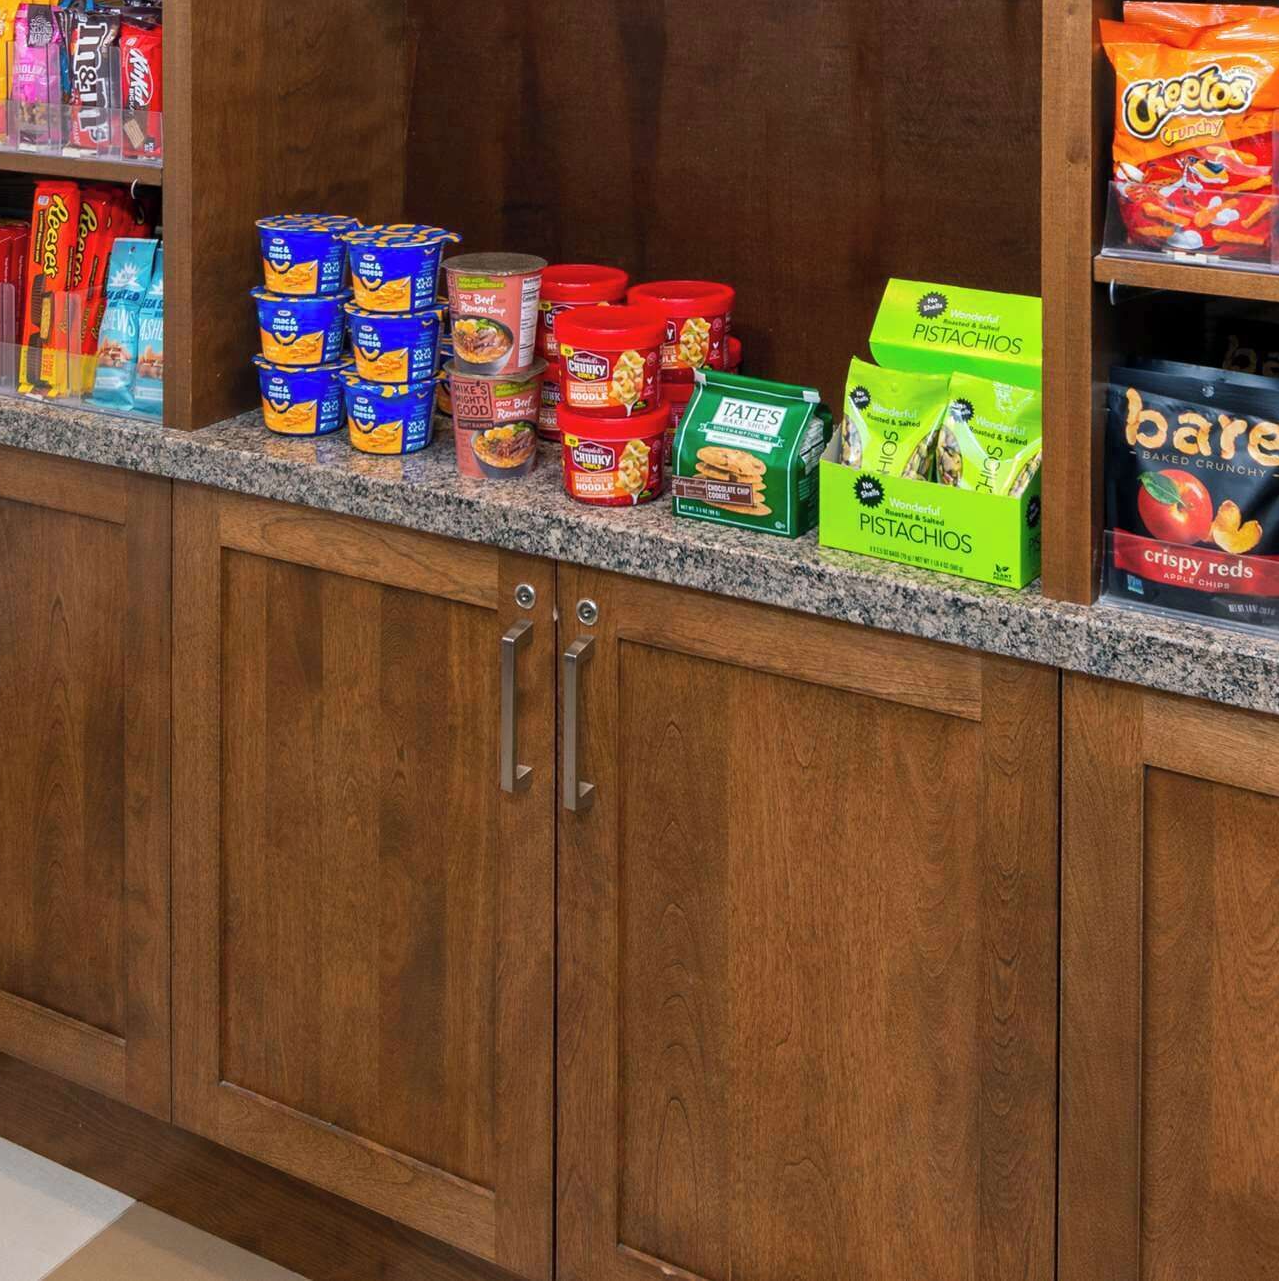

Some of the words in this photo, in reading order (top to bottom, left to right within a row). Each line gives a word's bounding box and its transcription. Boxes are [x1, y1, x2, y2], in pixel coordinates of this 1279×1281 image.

[1124, 64, 1256, 138] Cheetos
[1160, 118, 1224, 147] Crunchy
[42, 194, 69, 279] Reese's
[923, 302, 943, 312] Shells
[927, 297, 938, 305] No
[950, 309, 1000, 323] Wonderful
[943, 318, 970, 328] Roasted
[979, 323, 1000, 332] Salted
[913, 323, 1023, 355] PISTACHIOS
[569, 361, 607, 376] CHUNKY
[570, 392, 609, 400] NOODLE
[457, 404, 489, 417] GOOD
[723, 401, 782, 426] TATE'S
[573, 451, 612, 466] CHUNKY
[1142, 449, 1190, 468] BAKED
[1196, 457, 1267, 478] CRUNCHY
[575, 482, 614, 491] NOODLE
[707, 483, 736, 494] CHOCOLATE
[737, 487, 750, 496] CHIP
[862, 481, 873, 489] No
[708, 491, 730, 501] COOKIES
[860, 512, 973, 555] PISTACHIOS
[1144, 547, 1203, 576] crispy
[1208, 555, 1254, 579] reds
[1163, 571, 1196, 585] APPLE
[1198, 577, 1230, 590] CHIPS
